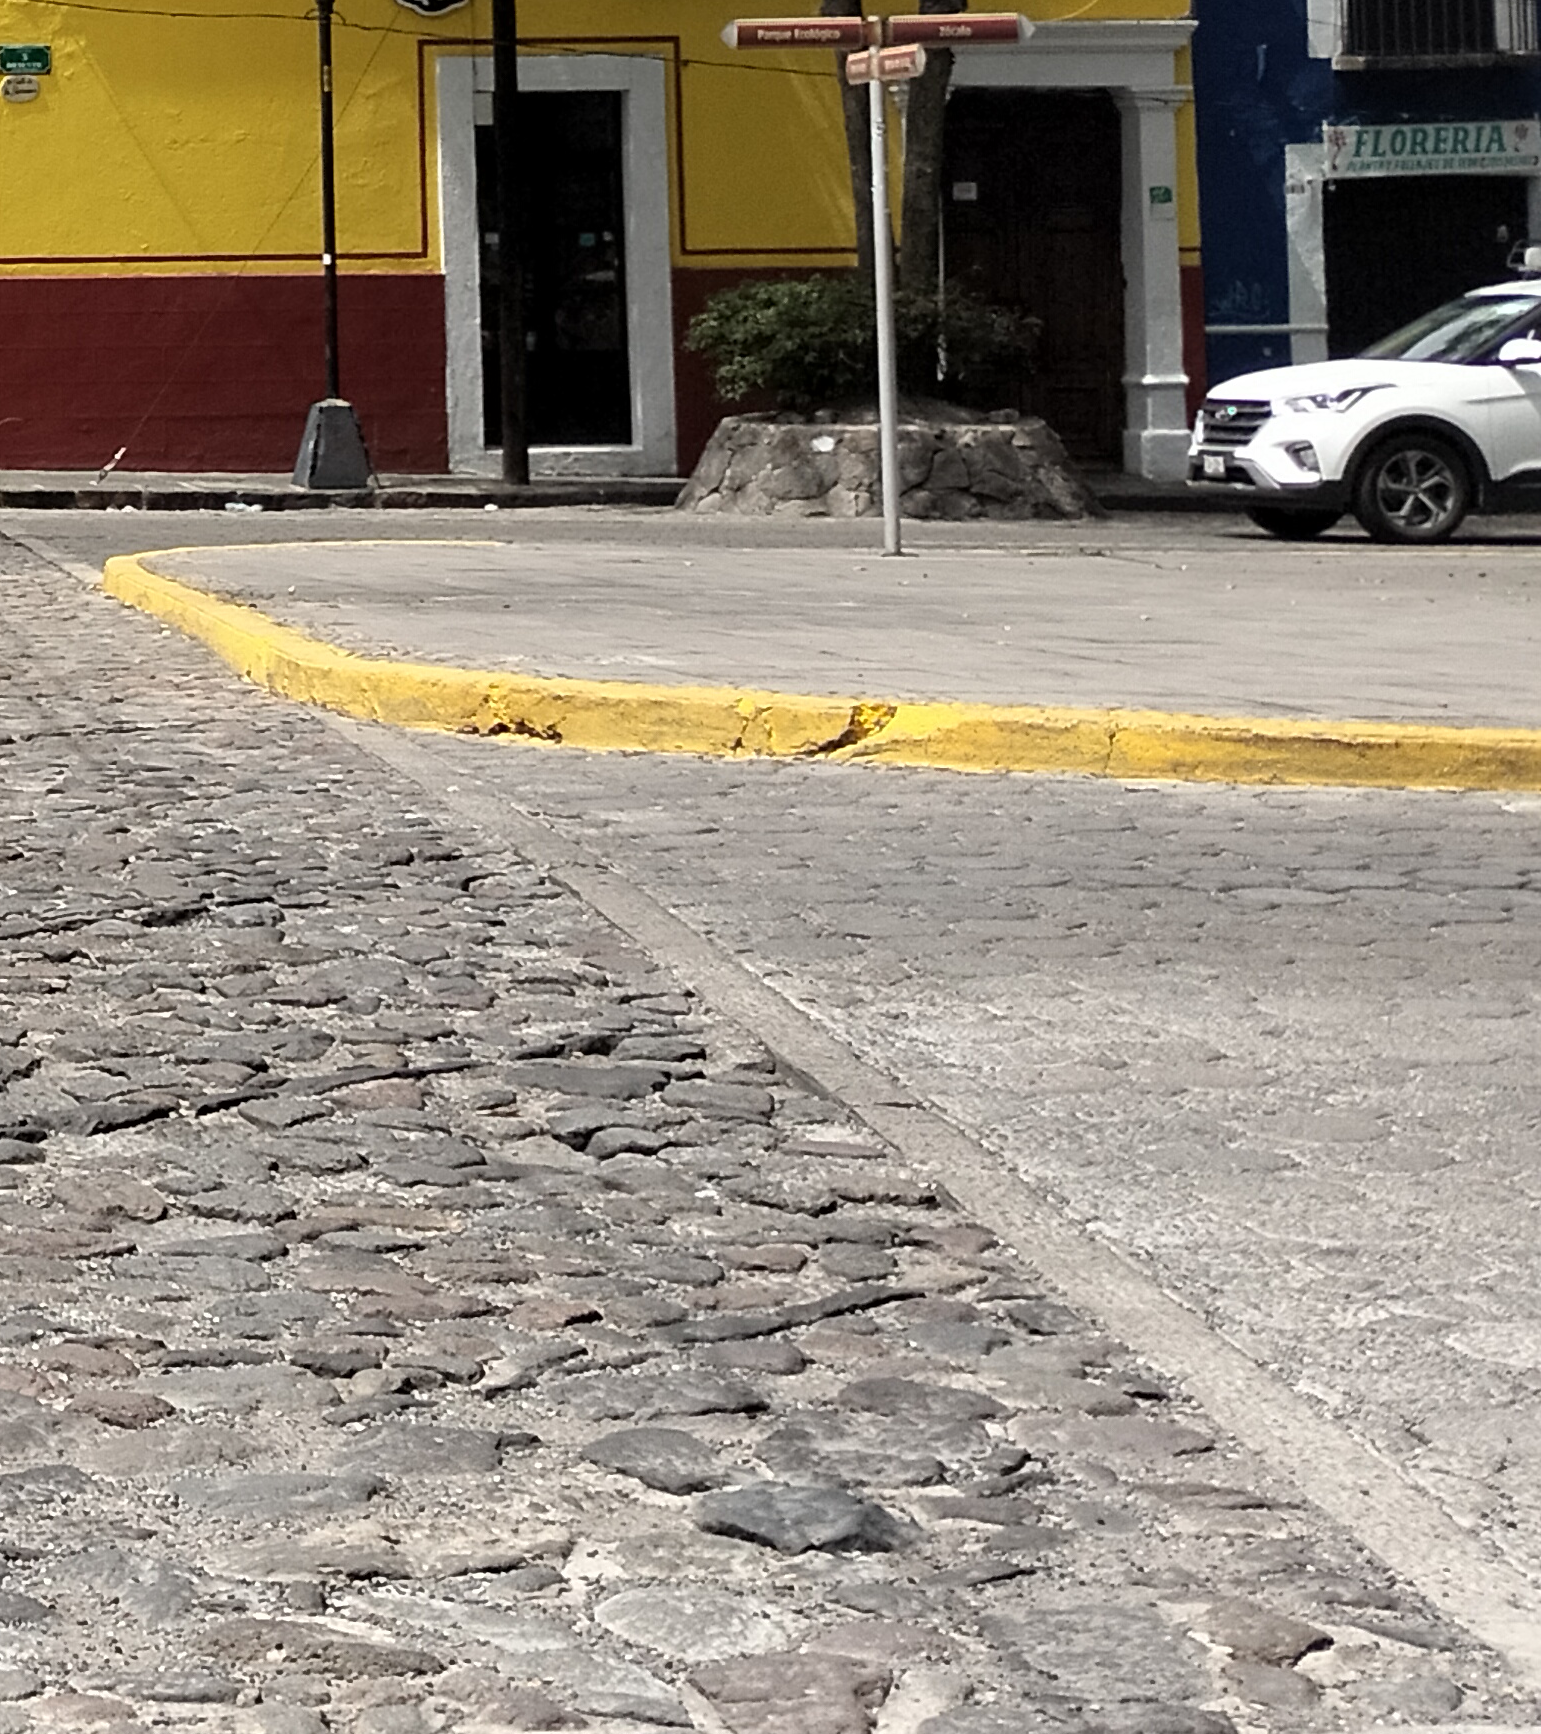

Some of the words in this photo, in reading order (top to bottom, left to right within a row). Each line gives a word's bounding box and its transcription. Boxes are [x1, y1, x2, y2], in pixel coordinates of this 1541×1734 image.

[757, 29, 792, 41] Parque
[794, 28, 840, 41] Ecológico
[1353, 124, 1507, 158] FLORERIA
